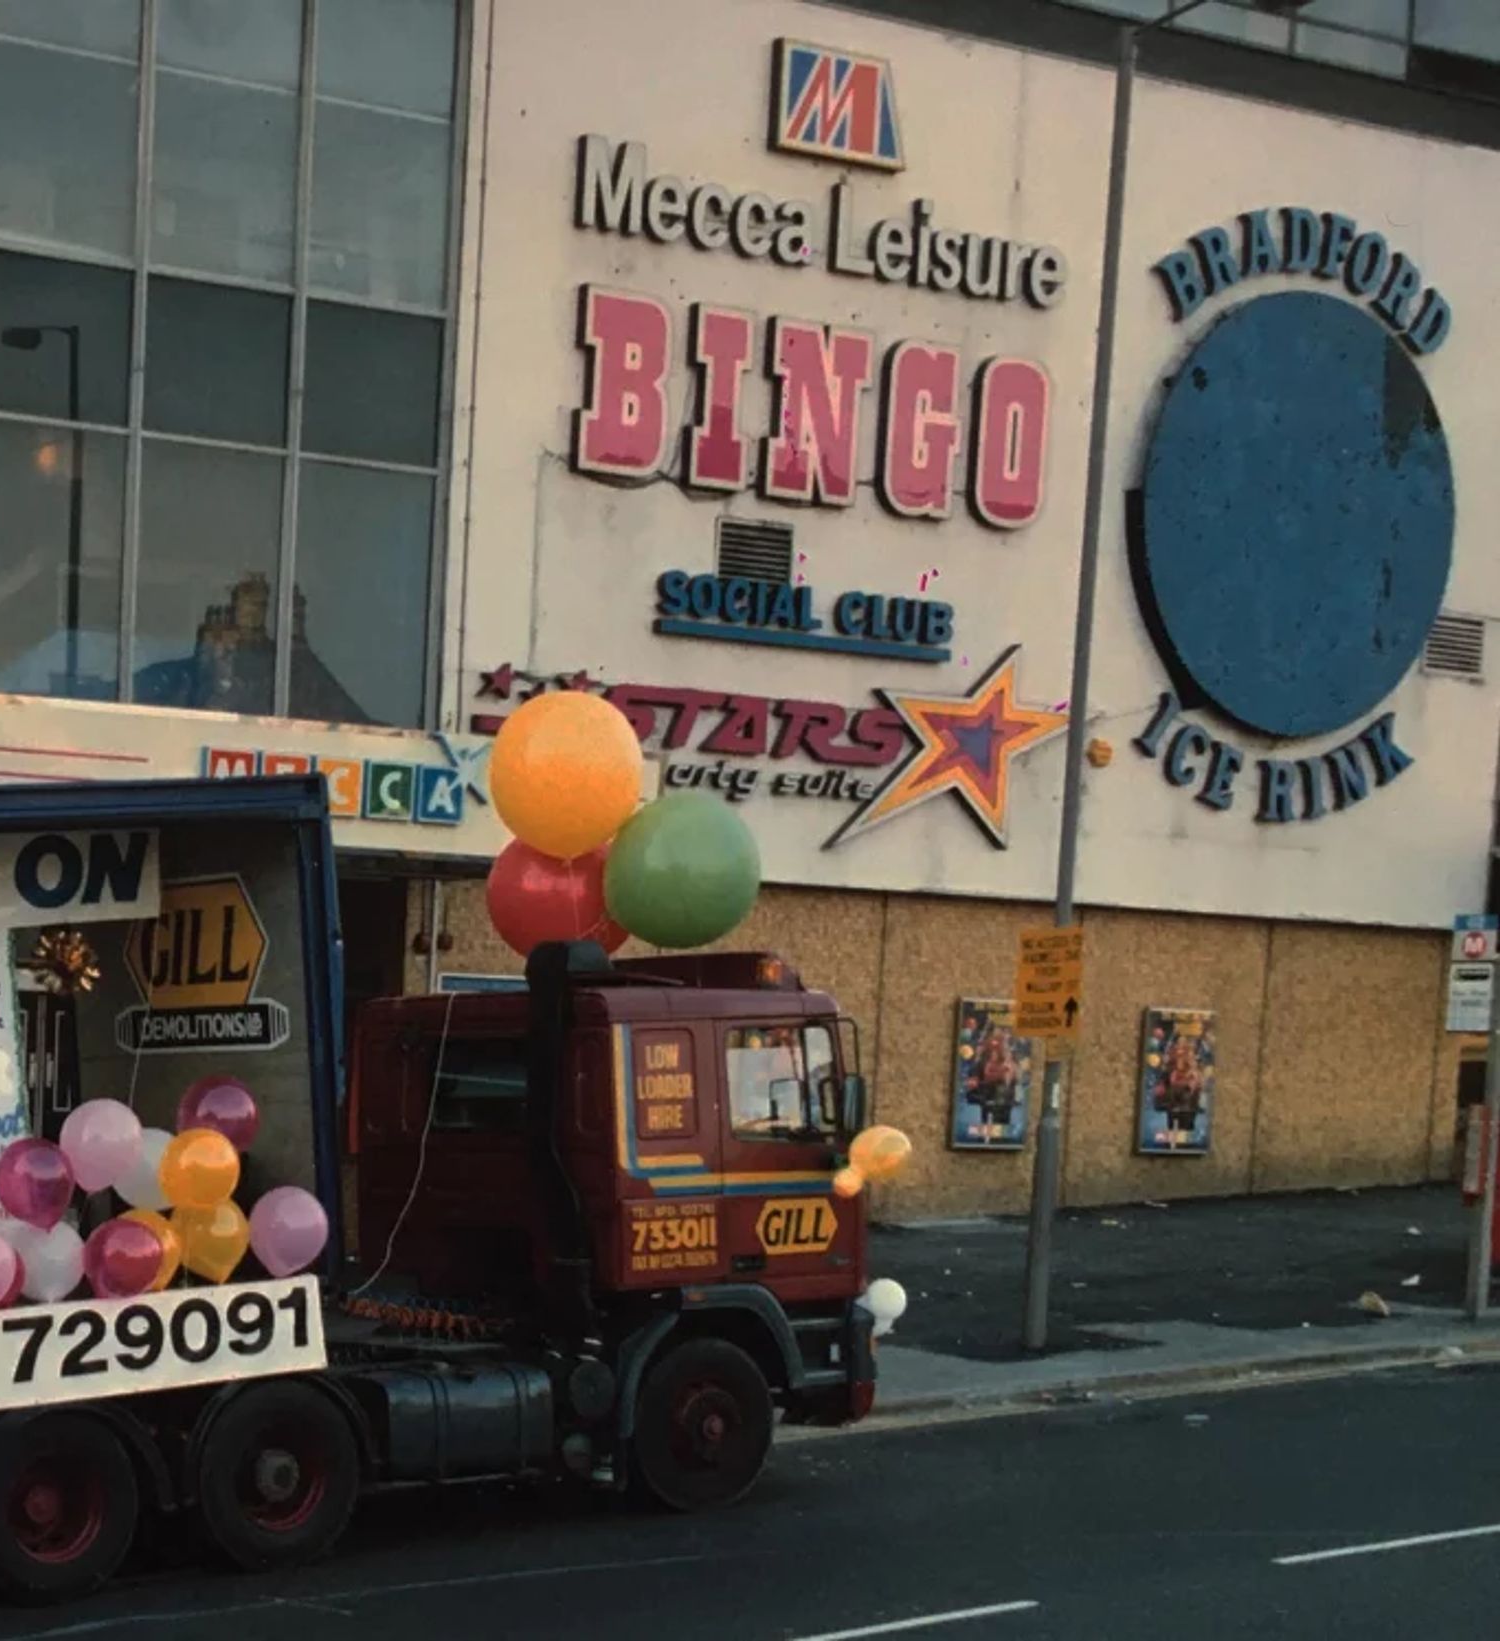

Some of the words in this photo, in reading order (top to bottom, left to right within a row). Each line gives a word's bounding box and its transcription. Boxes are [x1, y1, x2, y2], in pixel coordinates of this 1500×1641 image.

[576, 133, 813, 266] Mecca
[829, 180, 1067, 309] Leisure
[1153, 206, 1452, 356] BRADFORD
[570, 282, 1052, 530] BINGO
[655, 569, 822, 633] SOCIAL
[834, 590, 955, 645] CLUB
[1133, 690, 1244, 811] ICE
[1254, 712, 1414, 823] RINK
[14, 831, 150, 909] ON
[141, 906, 250, 987] GILL
[142, 1012, 244, 1040] DEMOLITIONS
[645, 1044, 679, 1069] LOW
[636, 1073, 693, 1100] LOADER
[631, 1217, 718, 1252] 733011
[762, 1207, 830, 1246] GILL
[2, 1291, 311, 1385] 729091
